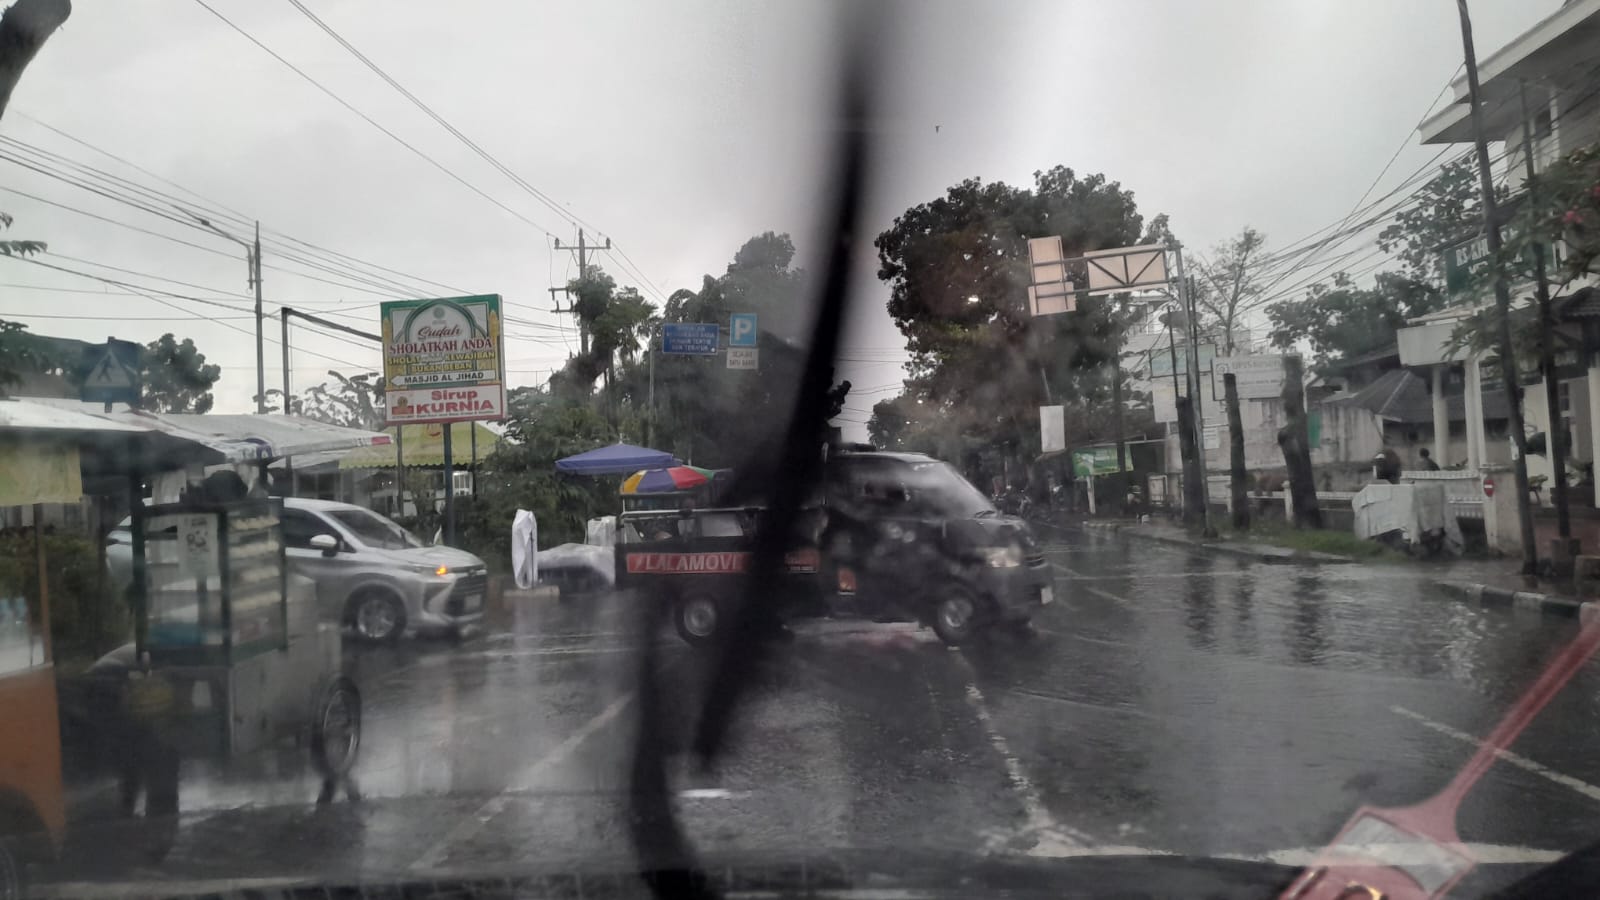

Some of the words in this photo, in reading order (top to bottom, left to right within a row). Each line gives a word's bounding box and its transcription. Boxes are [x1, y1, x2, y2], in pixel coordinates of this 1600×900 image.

[417, 325, 461, 341] Sudah
[735, 318, 752, 340] P
[390, 340, 457, 355] SHOLATKAH
[460, 337, 492, 350] ANDA
[404, 374, 439, 384] MASJID
[441, 373, 453, 381] AL
[456, 371, 484, 380] JIHAD
[431, 389, 478, 401] Sirup
[416, 400, 495, 414] KURNIA
